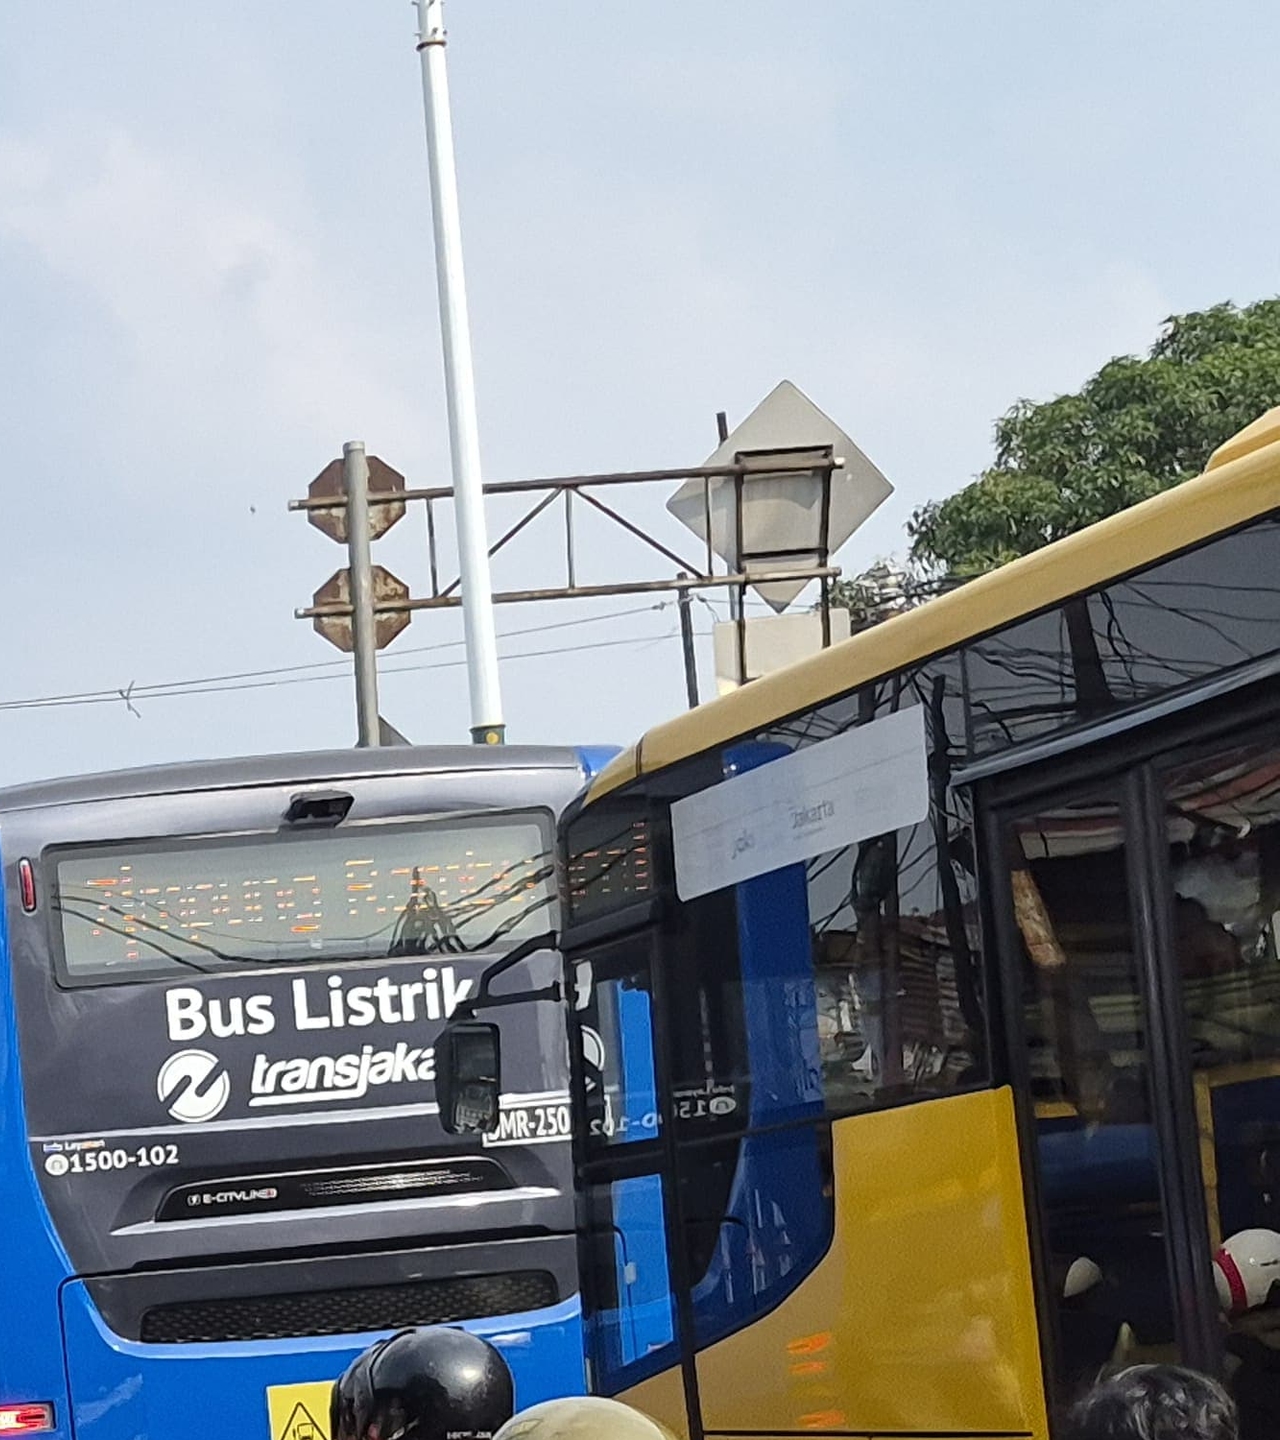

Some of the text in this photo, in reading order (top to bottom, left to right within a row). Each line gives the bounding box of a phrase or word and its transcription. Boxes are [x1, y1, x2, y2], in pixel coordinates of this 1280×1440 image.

[165, 967, 474, 1041] Bus Listrik
[249, 1042, 436, 1106] transjaka
[70, 1144, 179, 1173] 1500-102
